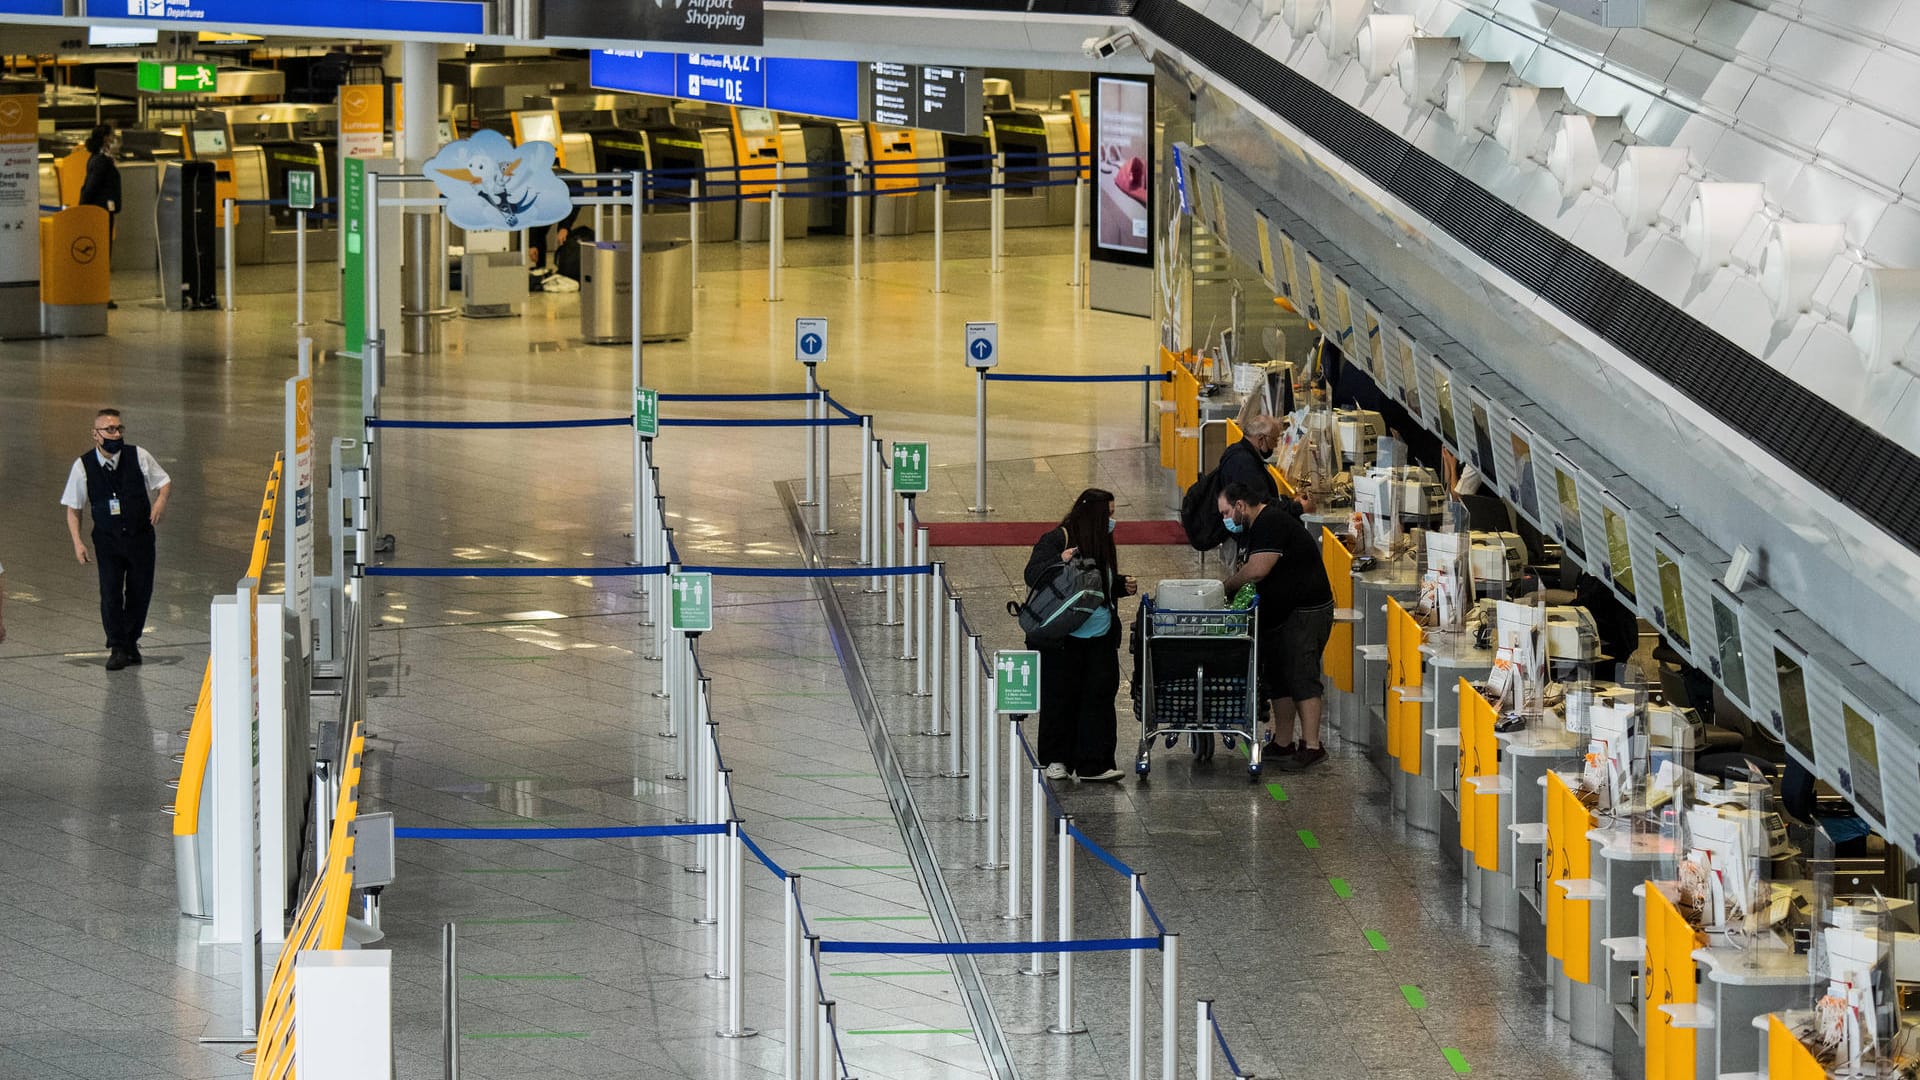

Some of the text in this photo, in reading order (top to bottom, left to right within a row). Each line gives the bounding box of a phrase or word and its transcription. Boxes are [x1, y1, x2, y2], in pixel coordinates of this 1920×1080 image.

[688, 0, 733, 11] Airport
[166, 7, 204, 18] Departures
[686, 9, 745, 30] Shopping
